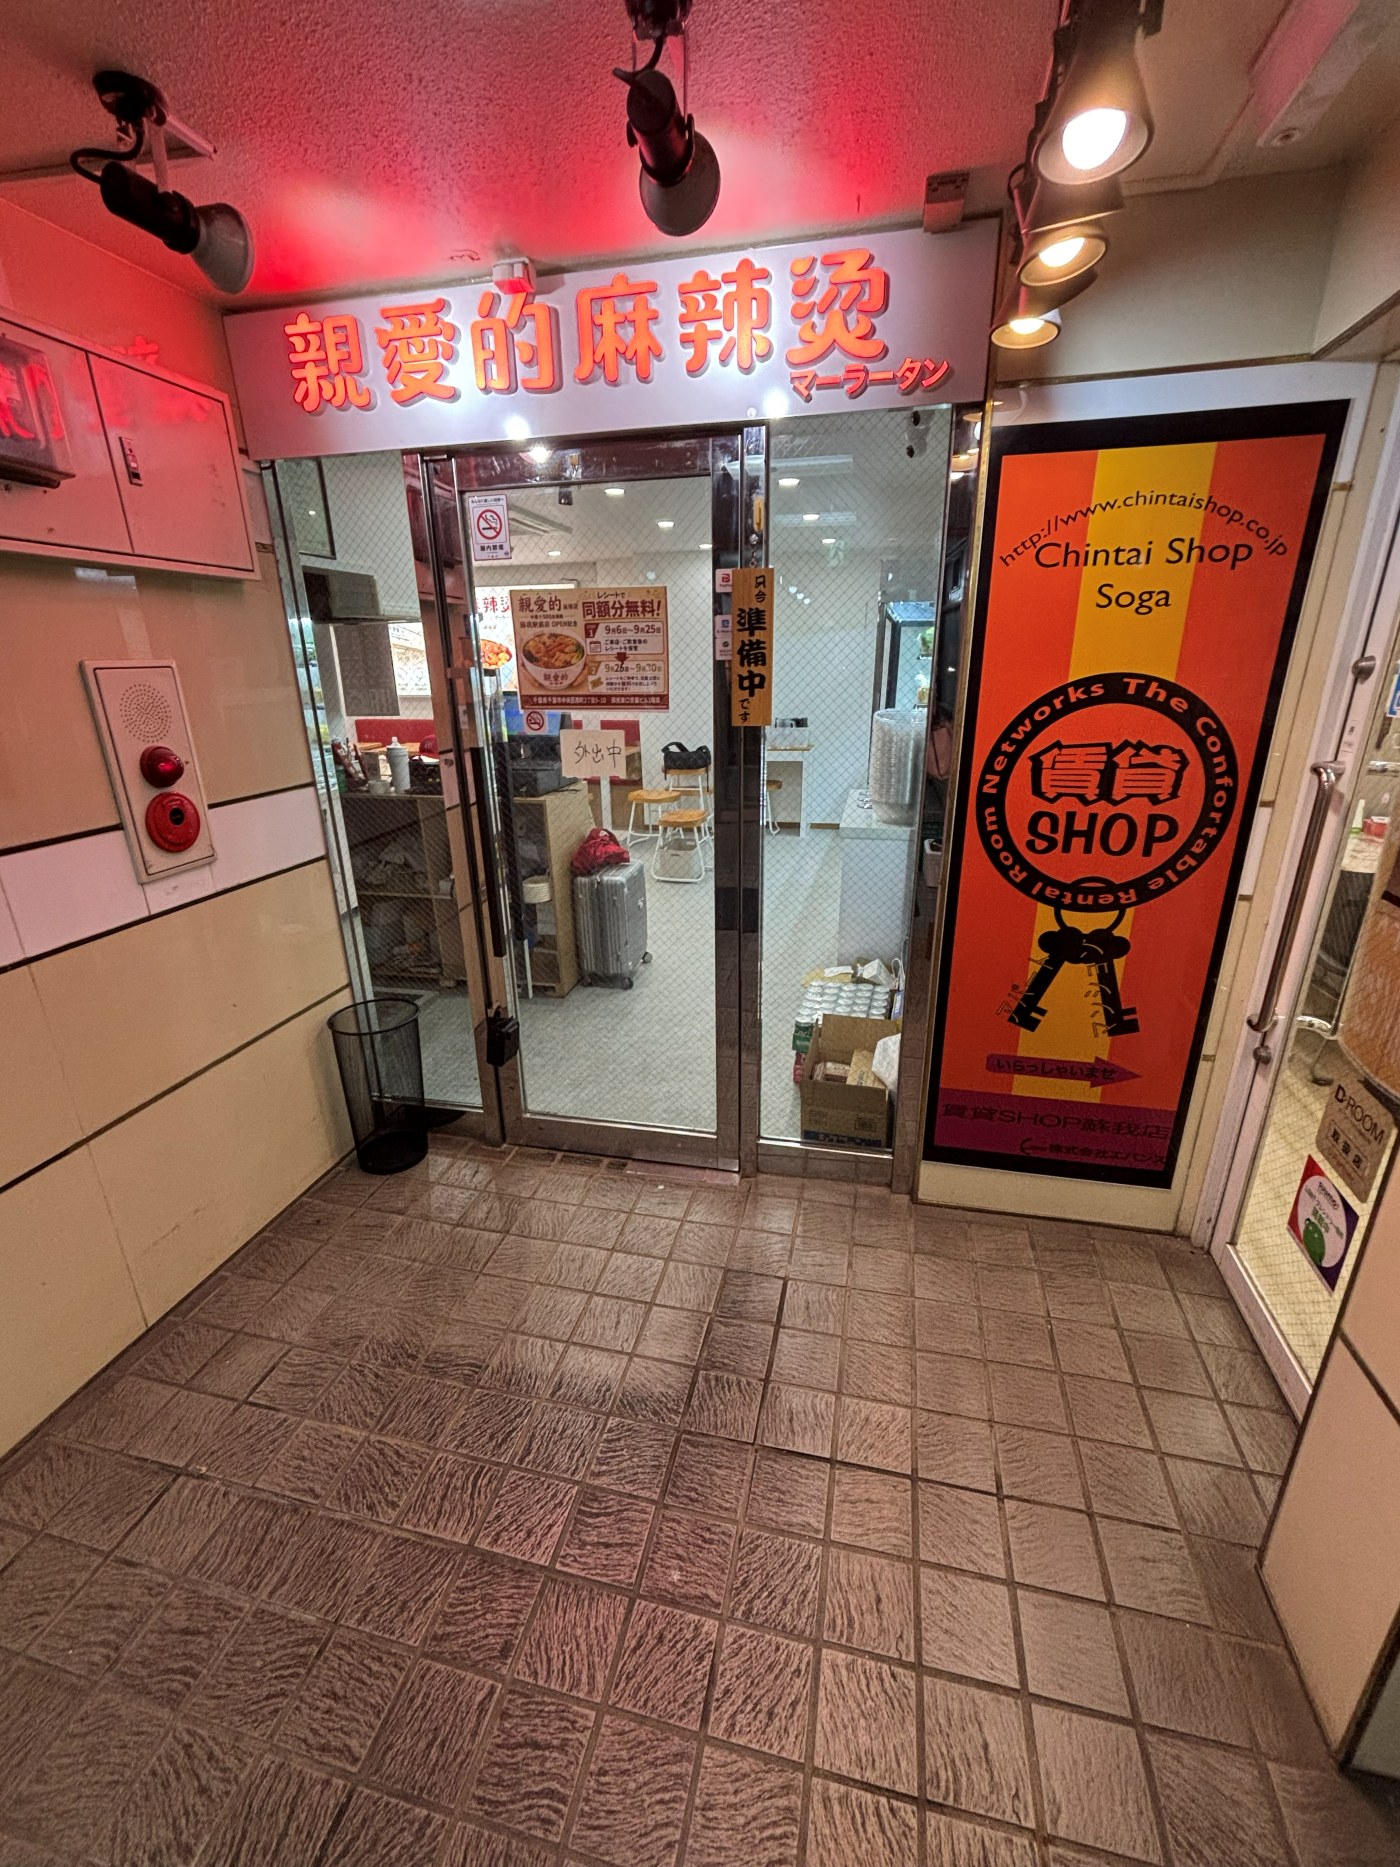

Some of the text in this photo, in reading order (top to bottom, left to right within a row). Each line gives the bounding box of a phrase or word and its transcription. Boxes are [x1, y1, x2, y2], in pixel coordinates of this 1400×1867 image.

[789, 357, 949, 400] マーラータン
[998, 490, 1288, 567] http://www.chintaishop.co.jp
[1034, 537, 1254, 570] Chintai Shop
[518, 595, 562, 612] 親愛的
[597, 591, 625, 599] レシートで
[1095, 583, 1172, 615] Soga
[736, 607, 767, 698] 準備中
[1123, 678, 1190, 714] The
[574, 739, 621, 768] 外出中
[982, 682, 1105, 794] Networks
[1032, 742, 1188, 804] 賃貸
[985, 806, 1028, 882] Room
[1025, 811, 1180, 858] SHOP
[1031, 887, 1138, 906] Rental
[996, 1057, 1117, 1081] いらっしゃいませ
